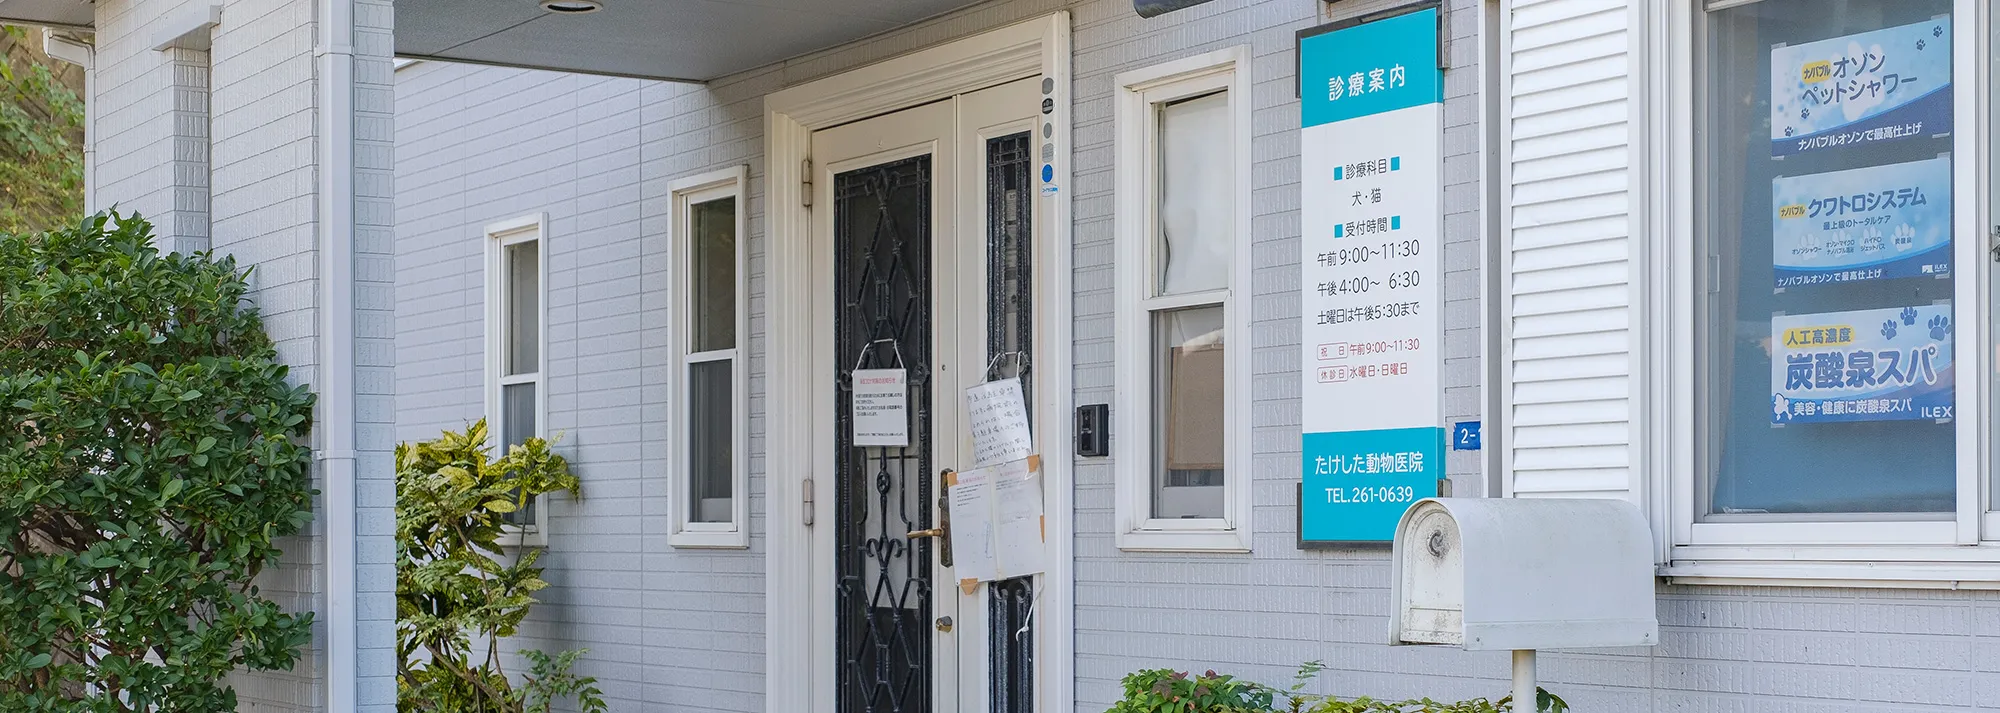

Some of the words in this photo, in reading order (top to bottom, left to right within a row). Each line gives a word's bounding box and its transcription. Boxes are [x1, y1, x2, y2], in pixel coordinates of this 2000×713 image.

[1804, 64, 1831, 80] ナノバブル
[1833, 52, 1886, 79] オゾン
[1328, 63, 1405, 101] 診療案内
[1802, 73, 1918, 105] ペットシャワー
[1798, 121, 1922, 151] ナノバブルオゾンで最高仕上げ
[1345, 158, 1388, 180] 診療科目
[1351, 188, 1382, 207] 犬・猫
[1781, 206, 1806, 217] ナノバブル
[1808, 187, 1927, 218] クワトロシステム
[1345, 217, 1388, 238] 受付時間
[1823, 215, 1891, 231] 最上級のトータルケア
[1777, 268, 1882, 287] ナノバブルオゾンで最高仕上げ
[1317, 301, 1420, 326] 土曜日は午後5:30まで
[1786, 327, 1851, 346] 人工高濃度
[1349, 362, 1408, 379] 水曜日・日曜日
[1785, 346, 1938, 391] 炭酸泉スパ
[1793, 398, 1912, 416] 美容・健康に炭酸泉スパ
[1921, 405, 1953, 418] ILEX
[1461, 427, 1481, 444] 2-
[1315, 451, 1424, 475] たけした動物医院
